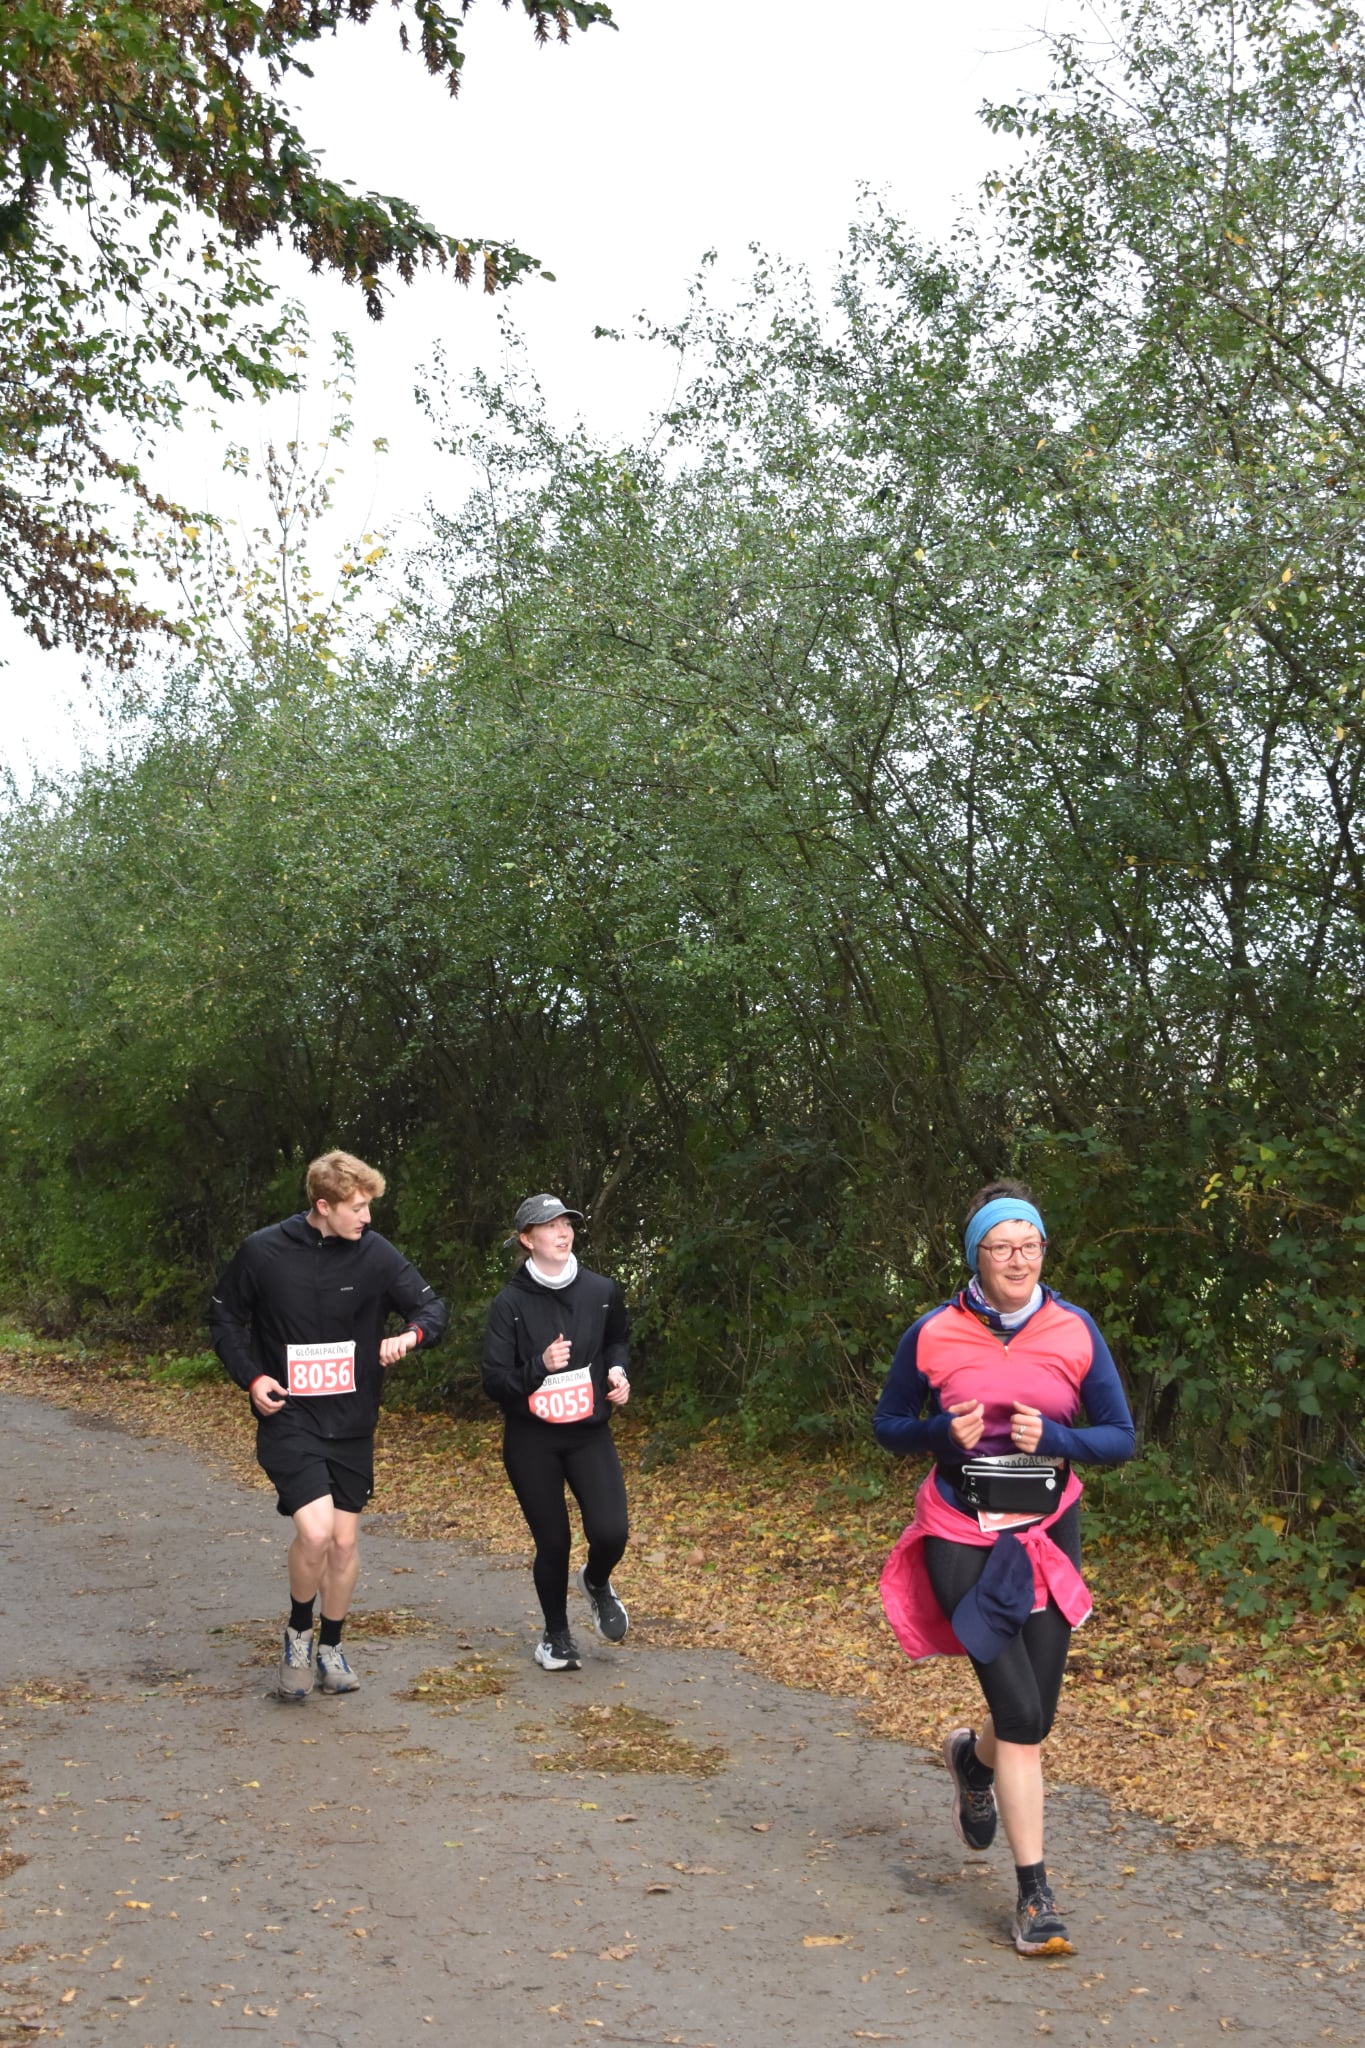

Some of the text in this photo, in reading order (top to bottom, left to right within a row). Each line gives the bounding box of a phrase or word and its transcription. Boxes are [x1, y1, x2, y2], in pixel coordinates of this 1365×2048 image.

[294, 1361, 351, 1389] 8056
[542, 1371, 587, 1387] OBALPACING
[534, 1387, 590, 1419] 8055
